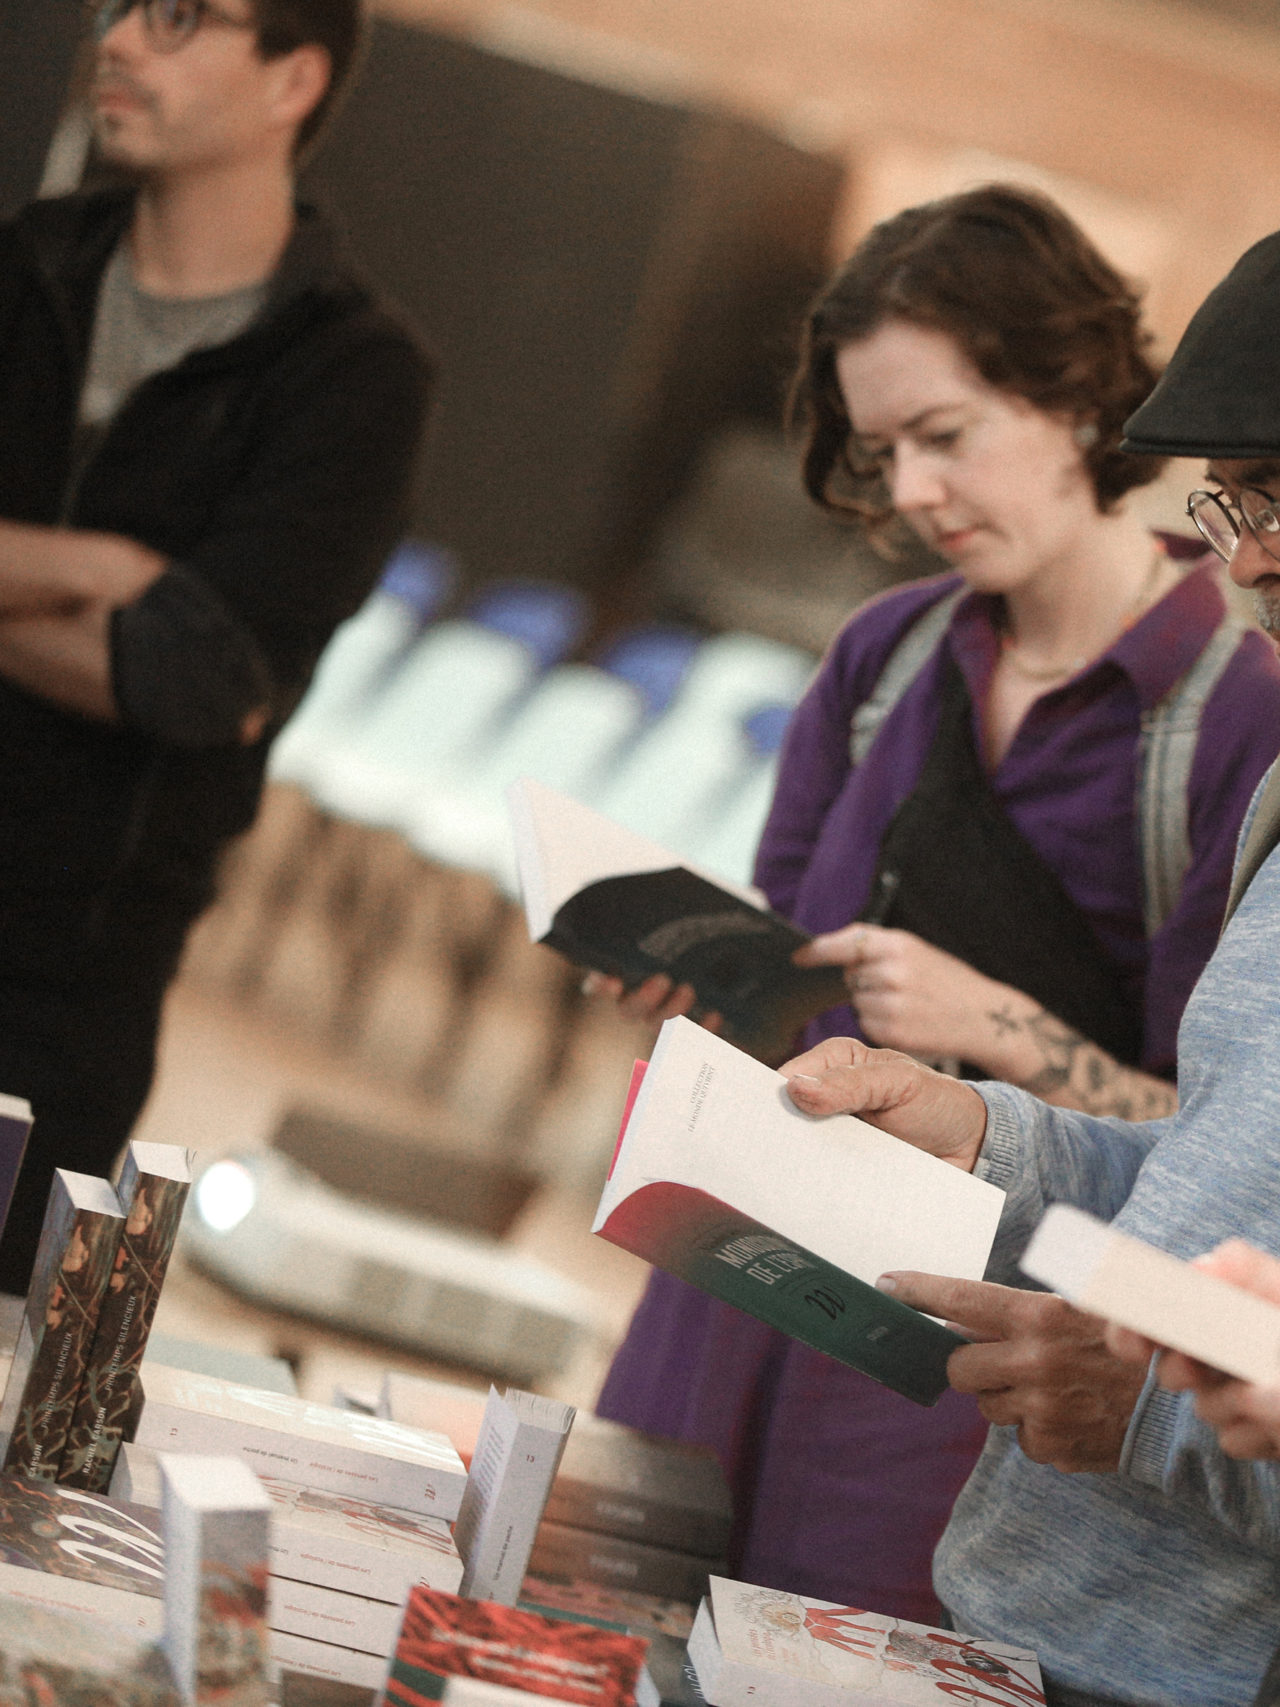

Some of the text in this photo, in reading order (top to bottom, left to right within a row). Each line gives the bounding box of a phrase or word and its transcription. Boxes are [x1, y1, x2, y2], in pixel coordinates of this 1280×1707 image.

[746, 1262, 783, 1286] DE
[105, 1295, 137, 1391] PRINTEMPS SILENCIEUX
[41, 1332, 73, 1429] PRINTEMPS SILENCIEUX
[28, 1444, 43, 1478] CARSON
[82, 1407, 107, 1474] RACHEL CARSON
